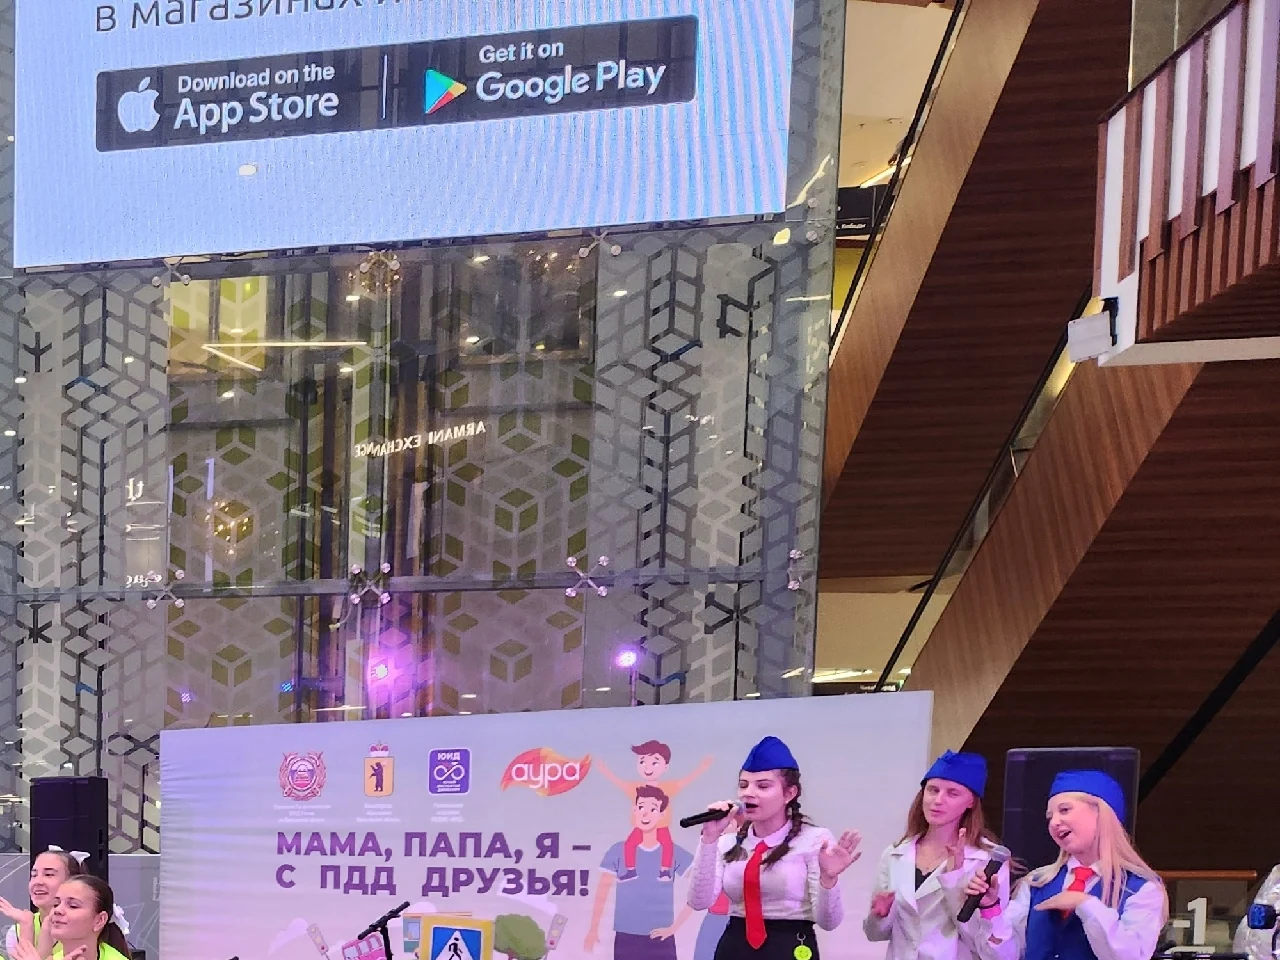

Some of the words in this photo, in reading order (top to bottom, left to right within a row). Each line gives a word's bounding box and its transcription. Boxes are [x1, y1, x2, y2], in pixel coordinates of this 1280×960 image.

[478, 44, 516, 64] Get
[520, 42, 534, 61] it
[537, 41, 564, 58] on
[178, 68, 270, 93] Download
[274, 67, 298, 85] on
[302, 63, 336, 82] the
[475, 64, 590, 104] Google
[595, 59, 667, 96] Play
[173, 97, 243, 135] App
[248, 91, 340, 124] Store
[511, 762, 581, 789] аура
[276, 831, 393, 862] МАМА,
[404, 832, 525, 864] ПАПА,
[535, 832, 560, 859] Я
[275, 863, 297, 889] С
[320, 865, 397, 896] ПДД
[421, 866, 590, 897] ДРУЗЬЯ!
